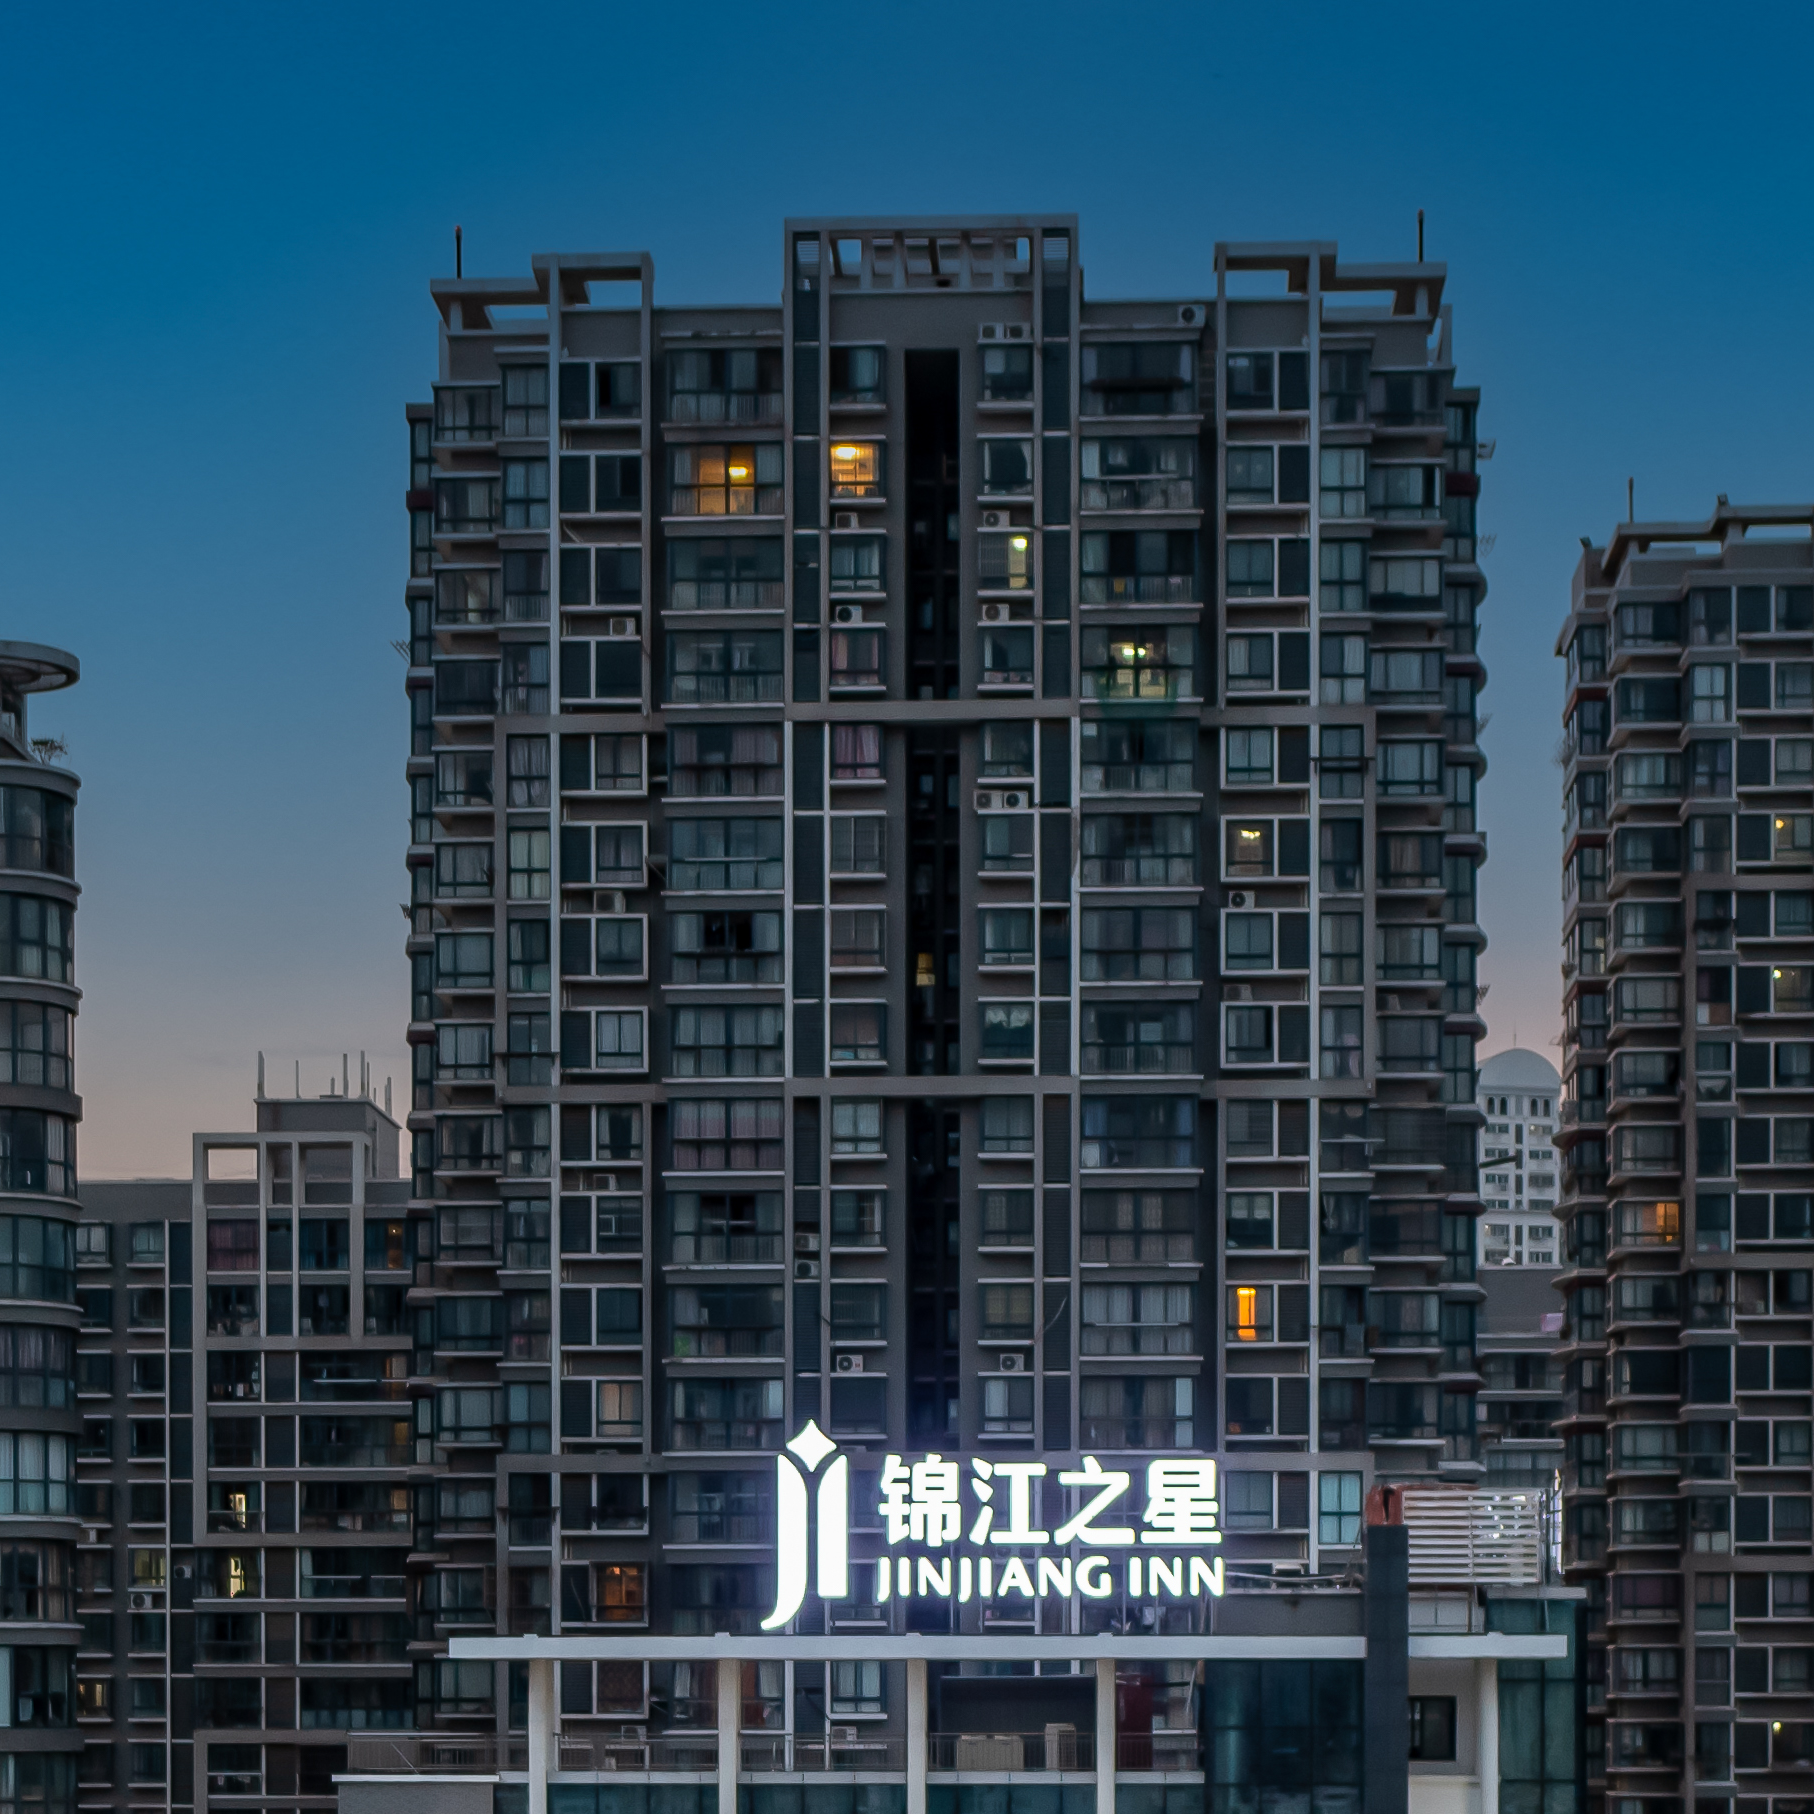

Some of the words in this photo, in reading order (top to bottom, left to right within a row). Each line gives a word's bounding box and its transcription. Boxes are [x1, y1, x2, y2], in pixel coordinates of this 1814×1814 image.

[878, 1454, 1222, 1547] 锦江之星
[877, 1556, 1112, 1603] JINJIANG
[1129, 1556, 1224, 1597] INN
